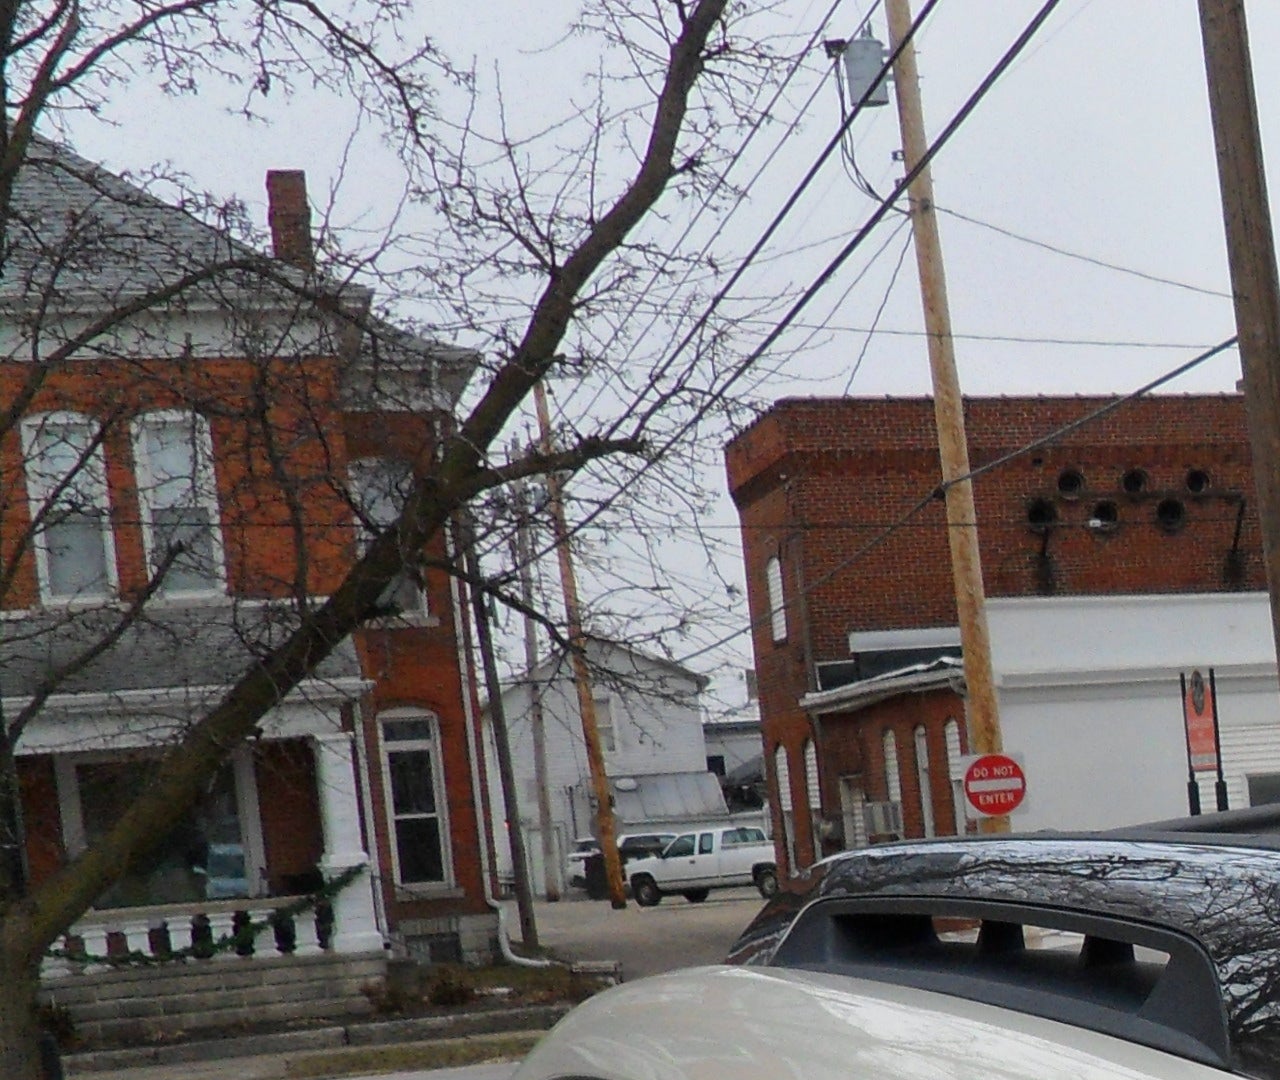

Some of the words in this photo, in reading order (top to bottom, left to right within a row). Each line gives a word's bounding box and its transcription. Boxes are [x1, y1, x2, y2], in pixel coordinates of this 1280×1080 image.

[973, 767, 989, 778] DO
[993, 765, 1014, 777] NOT
[979, 792, 1014, 805] ENTER
